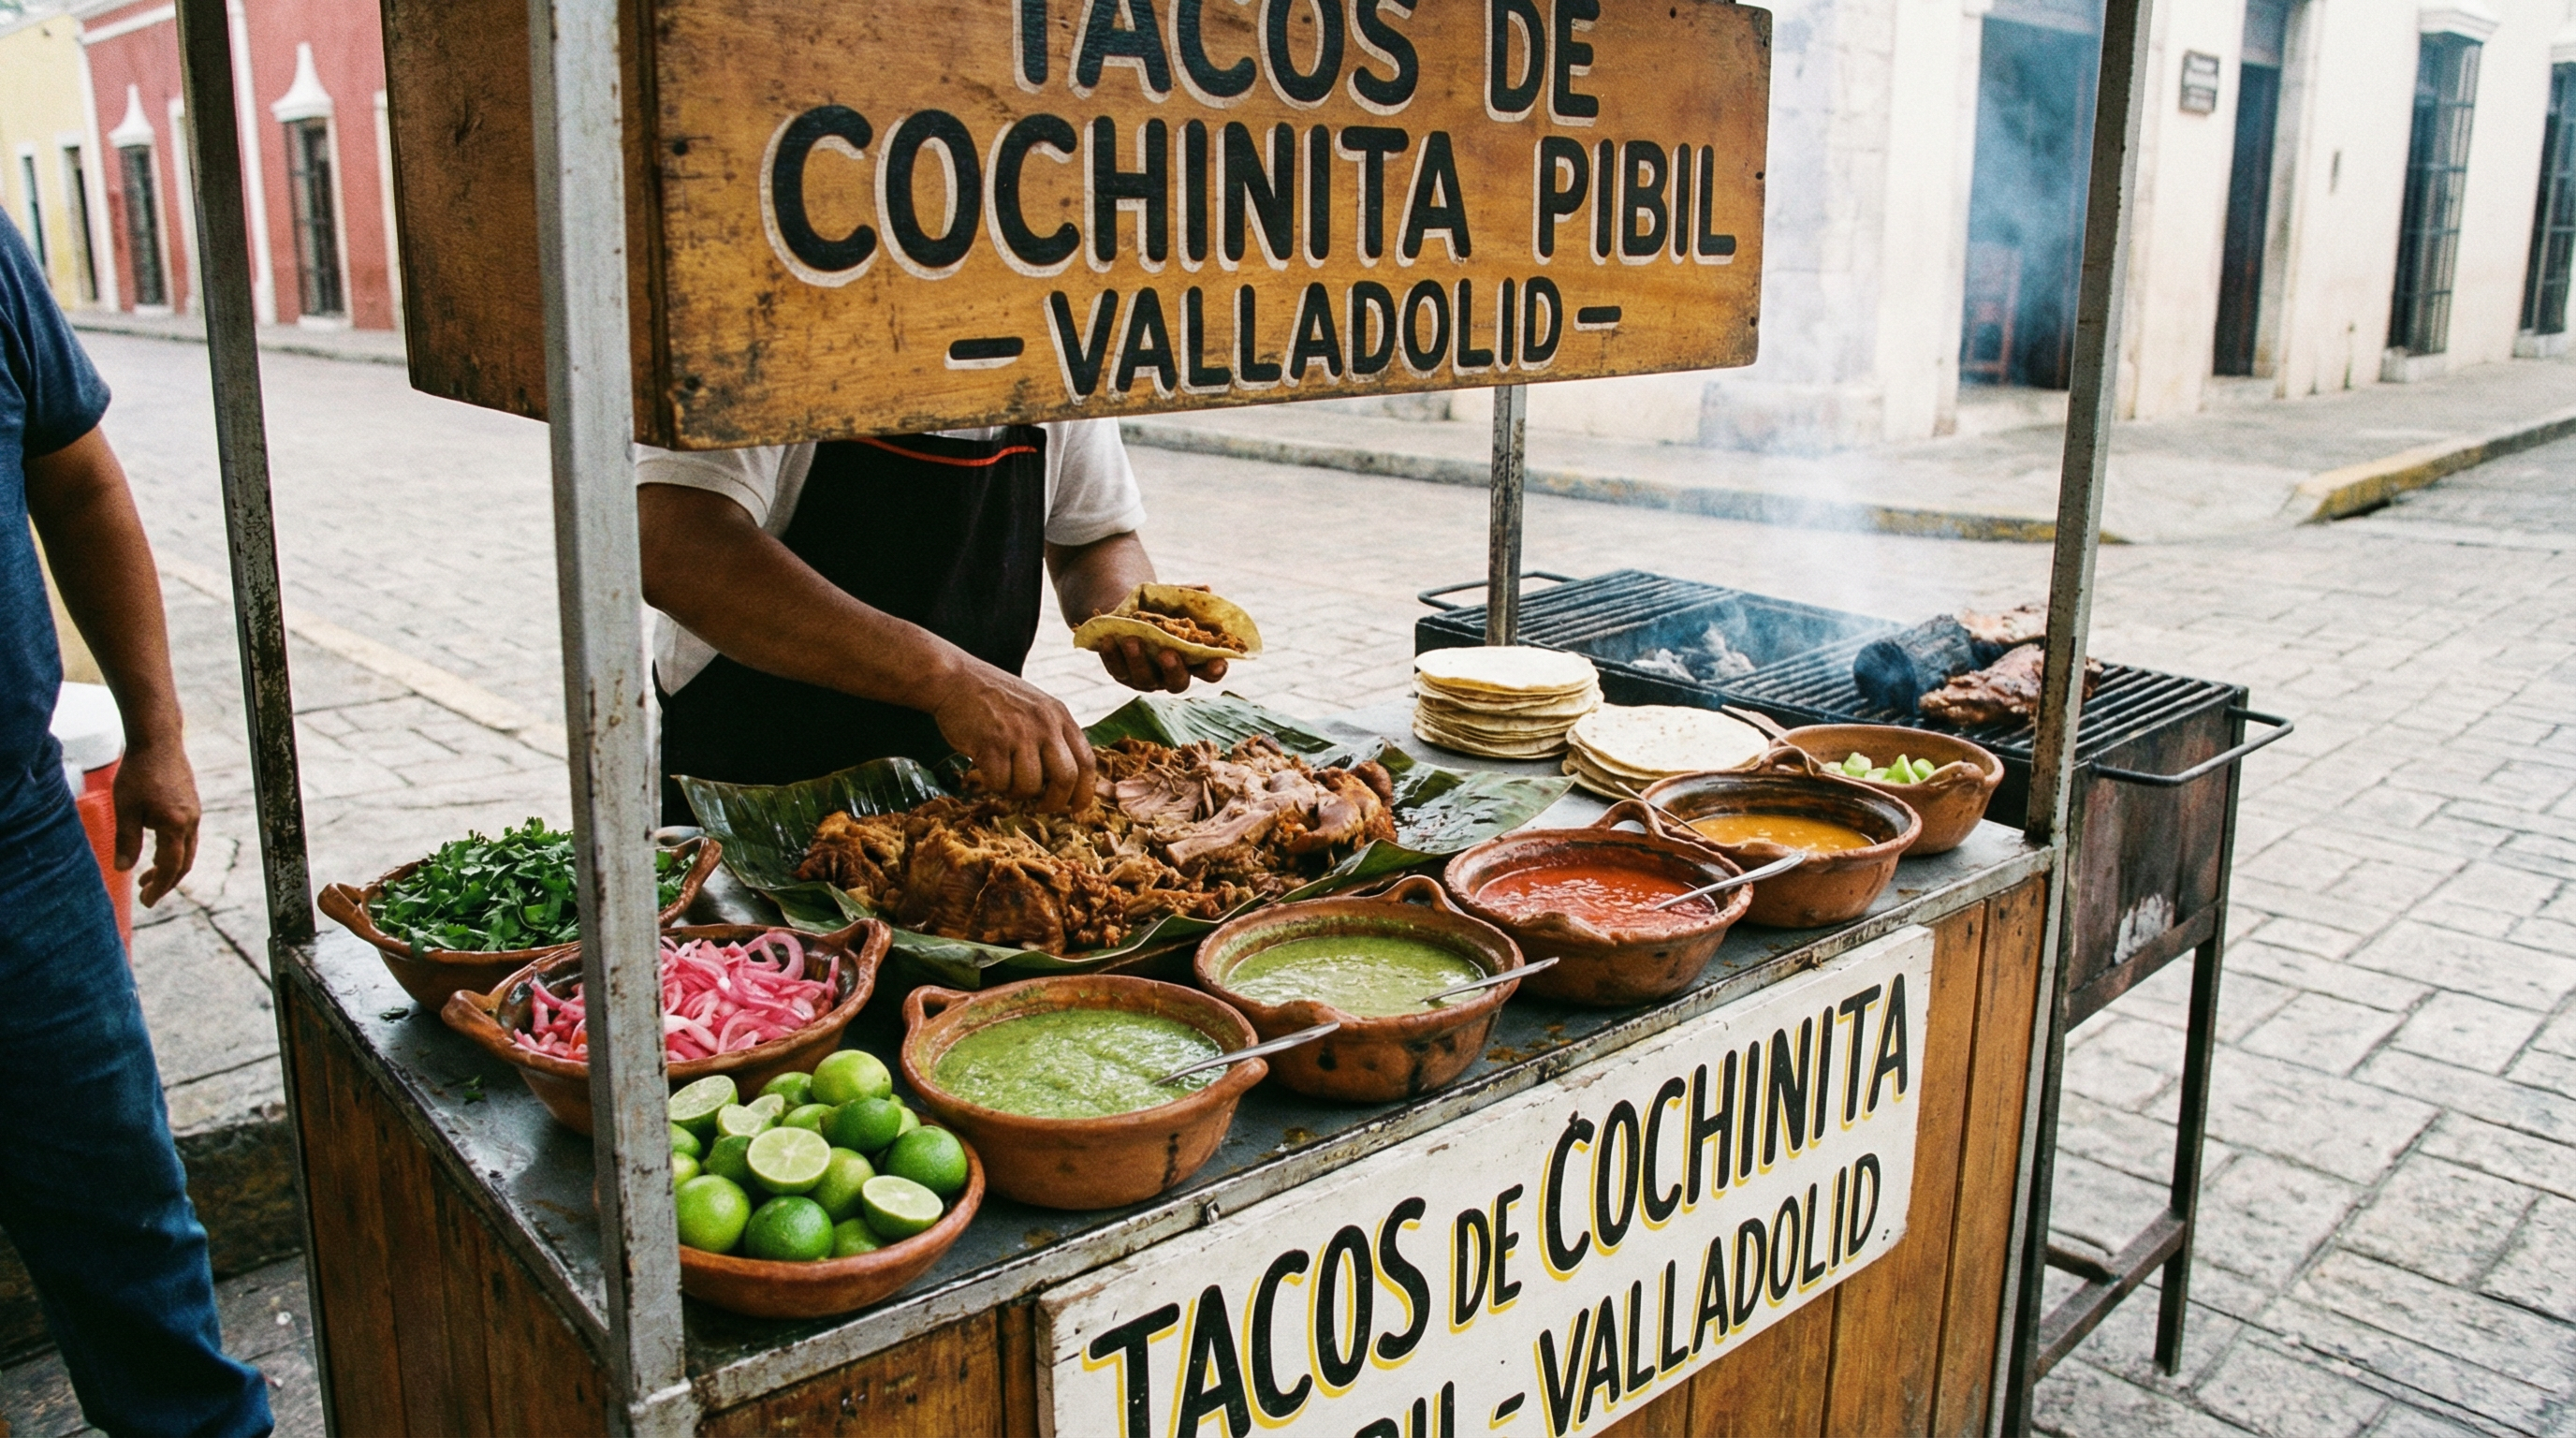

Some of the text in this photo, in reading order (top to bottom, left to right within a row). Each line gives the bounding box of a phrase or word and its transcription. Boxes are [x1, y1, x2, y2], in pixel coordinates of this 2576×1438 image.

[1484, 0, 1602, 124] DE
[765, 104, 1736, 285] COCHINITA PIBIL
[1042, 275, 1563, 403] VALLADOLID
[1084, 973, 1908, 1438] TACOS DE COCHINITA
[1534, 1153, 1881, 1438] VALLADOLID
